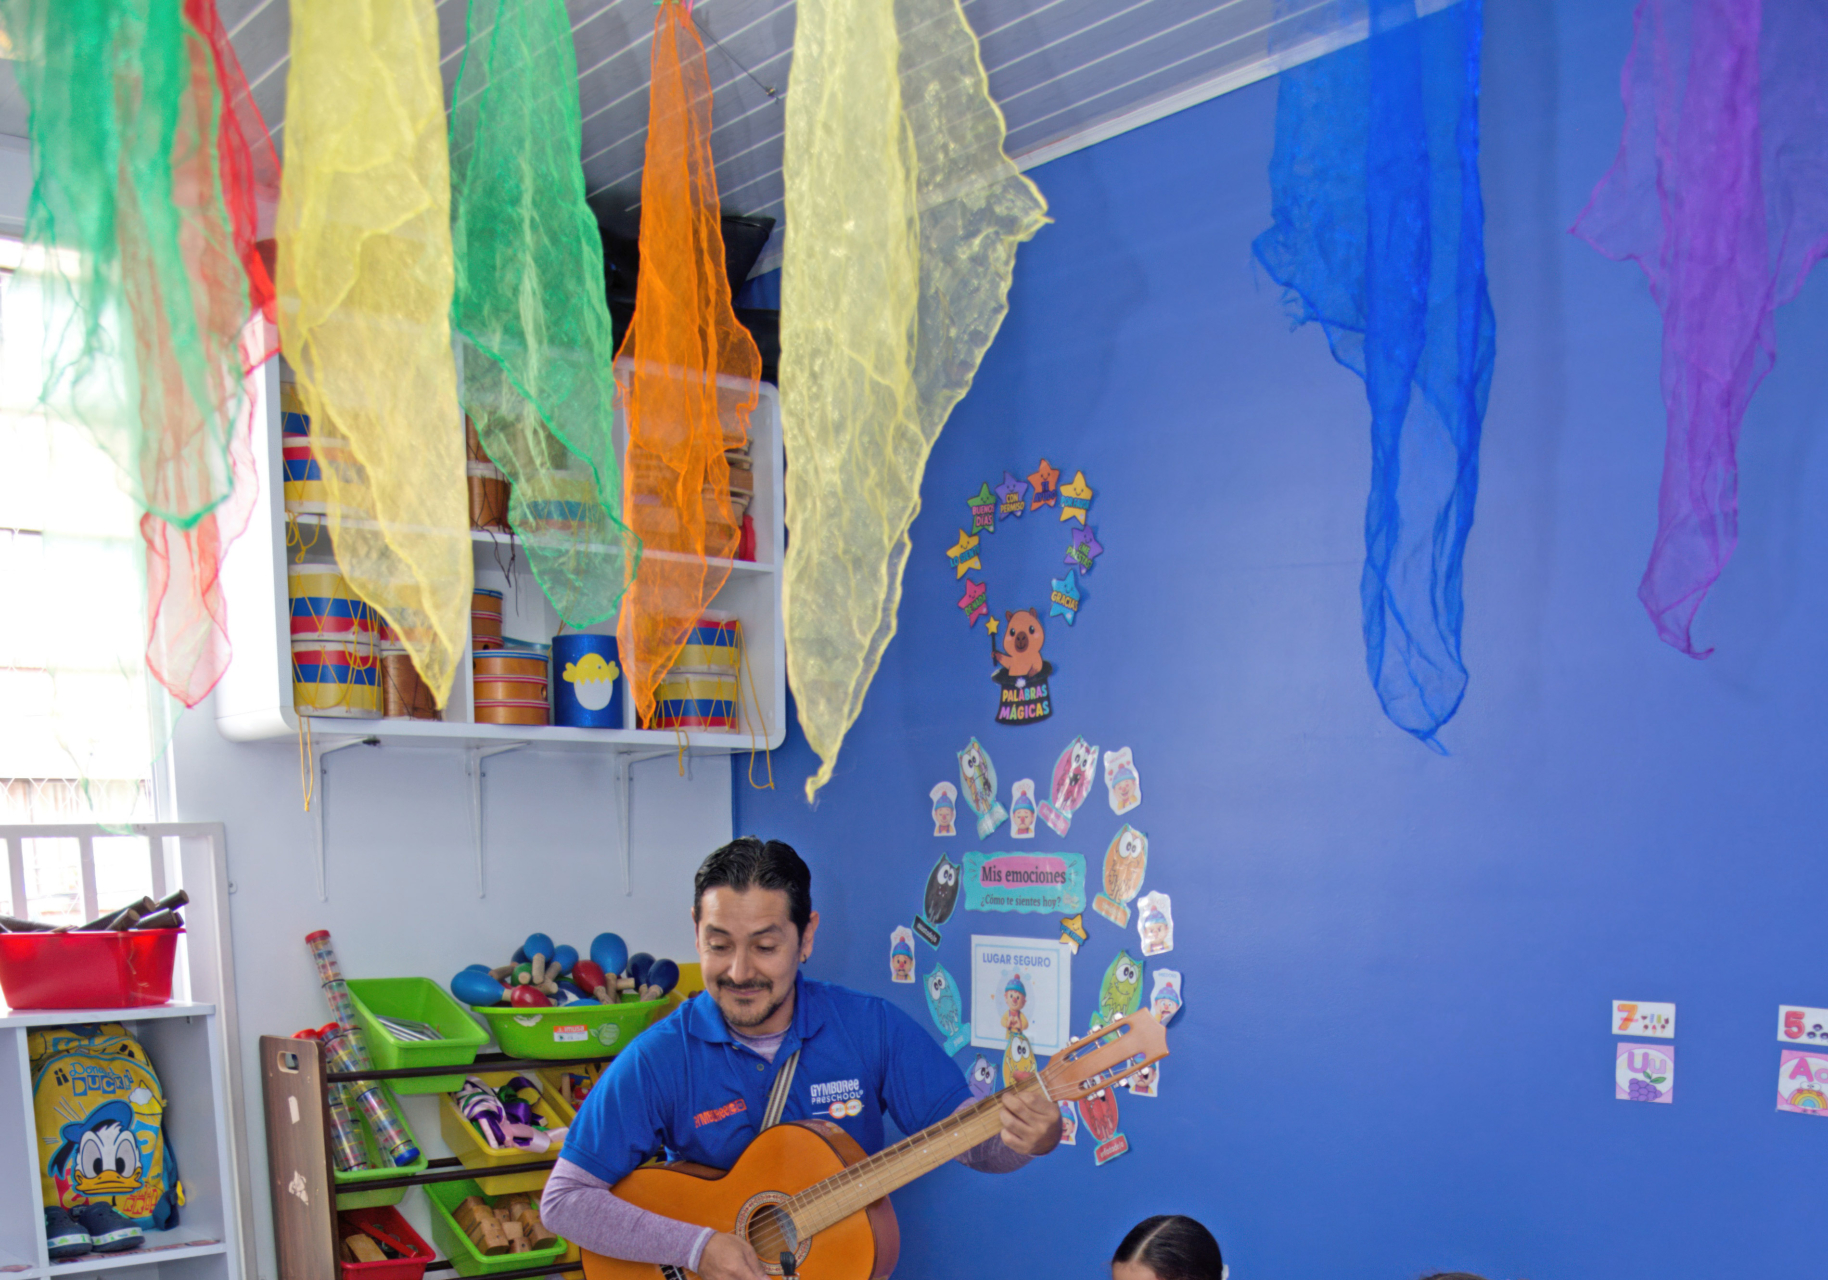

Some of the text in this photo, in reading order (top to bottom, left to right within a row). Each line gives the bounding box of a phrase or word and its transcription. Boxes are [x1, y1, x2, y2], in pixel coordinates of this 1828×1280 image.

[1006, 492, 1018, 503] CON
[1060, 496, 1073, 507] POR
[1000, 501, 1025, 513] PERMISO
[975, 514, 993, 527] DÍAS
[950, 556, 959, 568] LO
[1051, 590, 1079, 612] GRACIAS
[964, 604, 973, 617] DE
[1002, 684, 1048, 702] PALABRAS
[999, 700, 1050, 720] MÁGICAS
[981, 865, 1067, 885] Mis emociones
[980, 893, 1062, 909] ¿Cómo te sientes hoy?
[982, 952, 1052, 968] LUGAR SEGURO
[1617, 1003, 1638, 1031] 7
[1784, 1010, 1806, 1039] 5
